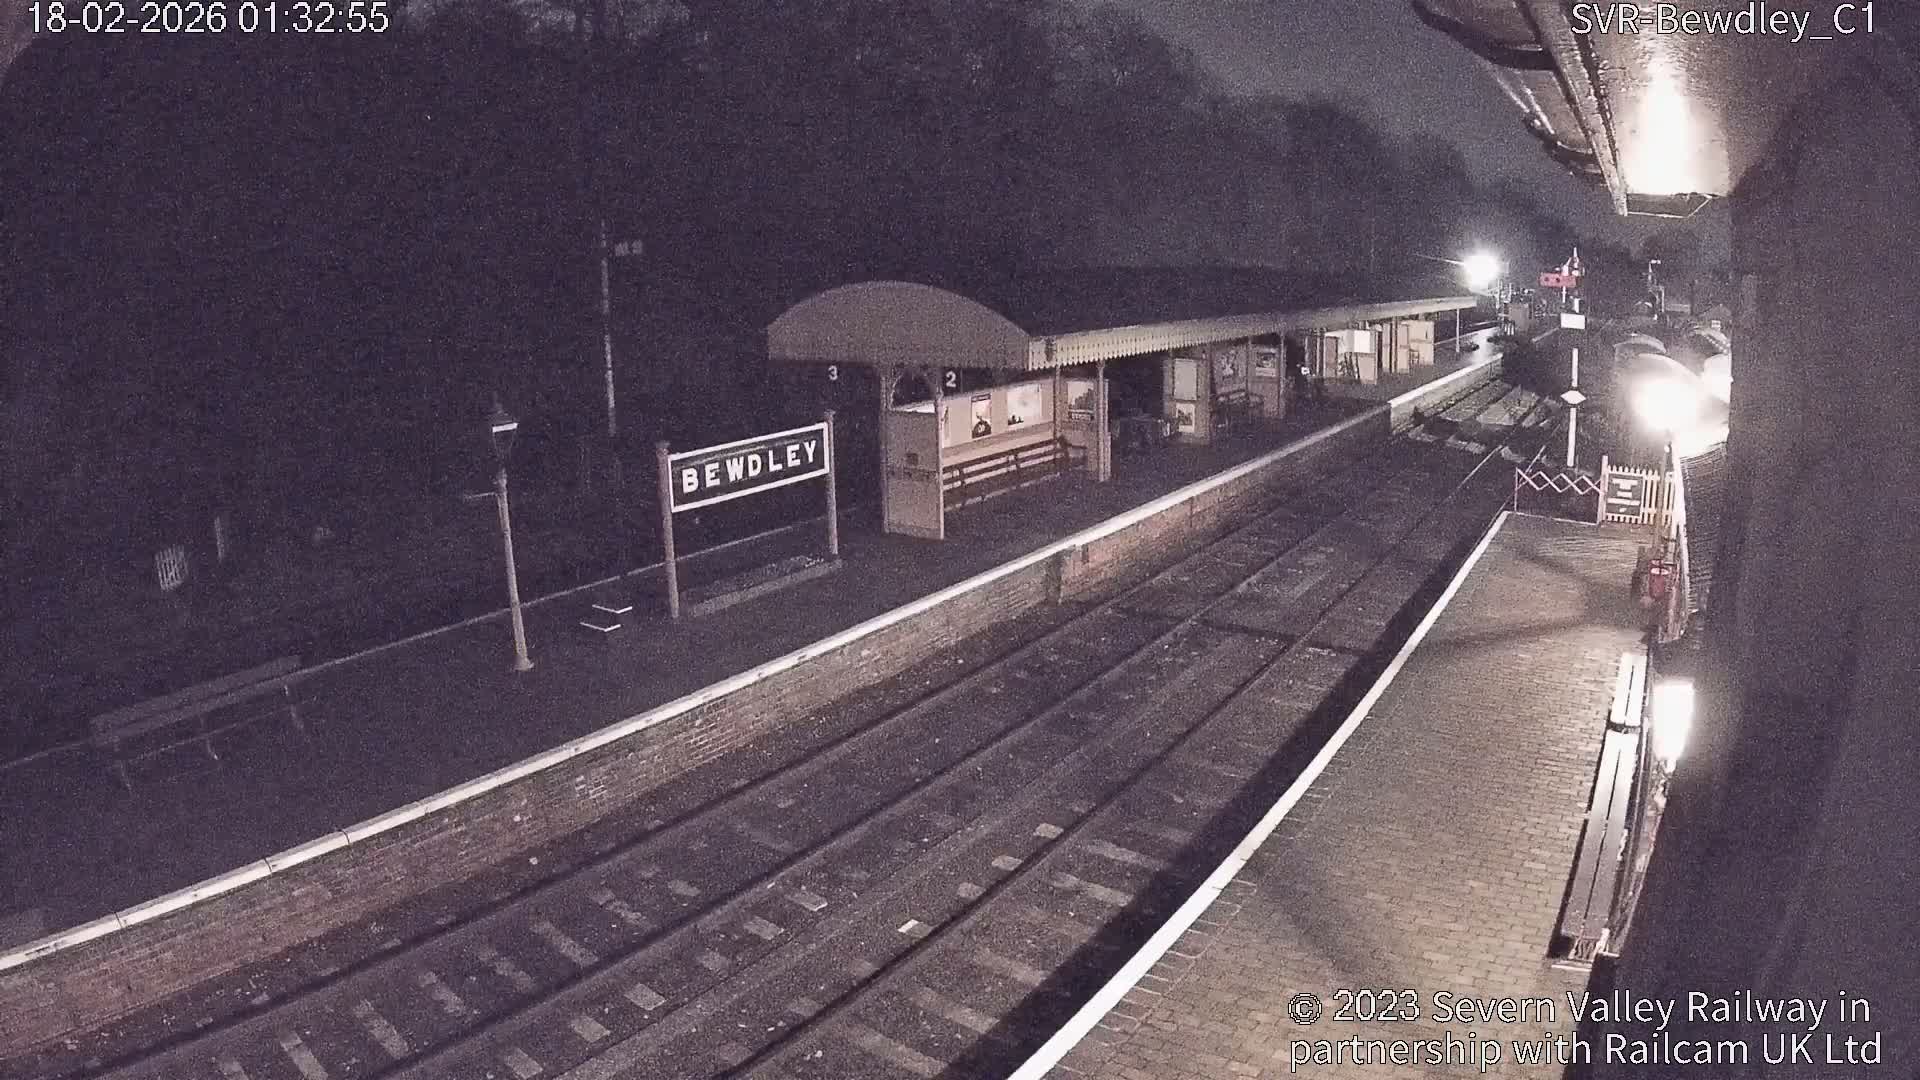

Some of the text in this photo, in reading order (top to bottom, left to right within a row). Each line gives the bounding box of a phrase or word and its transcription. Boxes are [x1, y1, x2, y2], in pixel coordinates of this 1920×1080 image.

[828, 366, 838, 381] 3
[945, 371, 957, 388] 2
[681, 440, 817, 494] BEWDLEY
